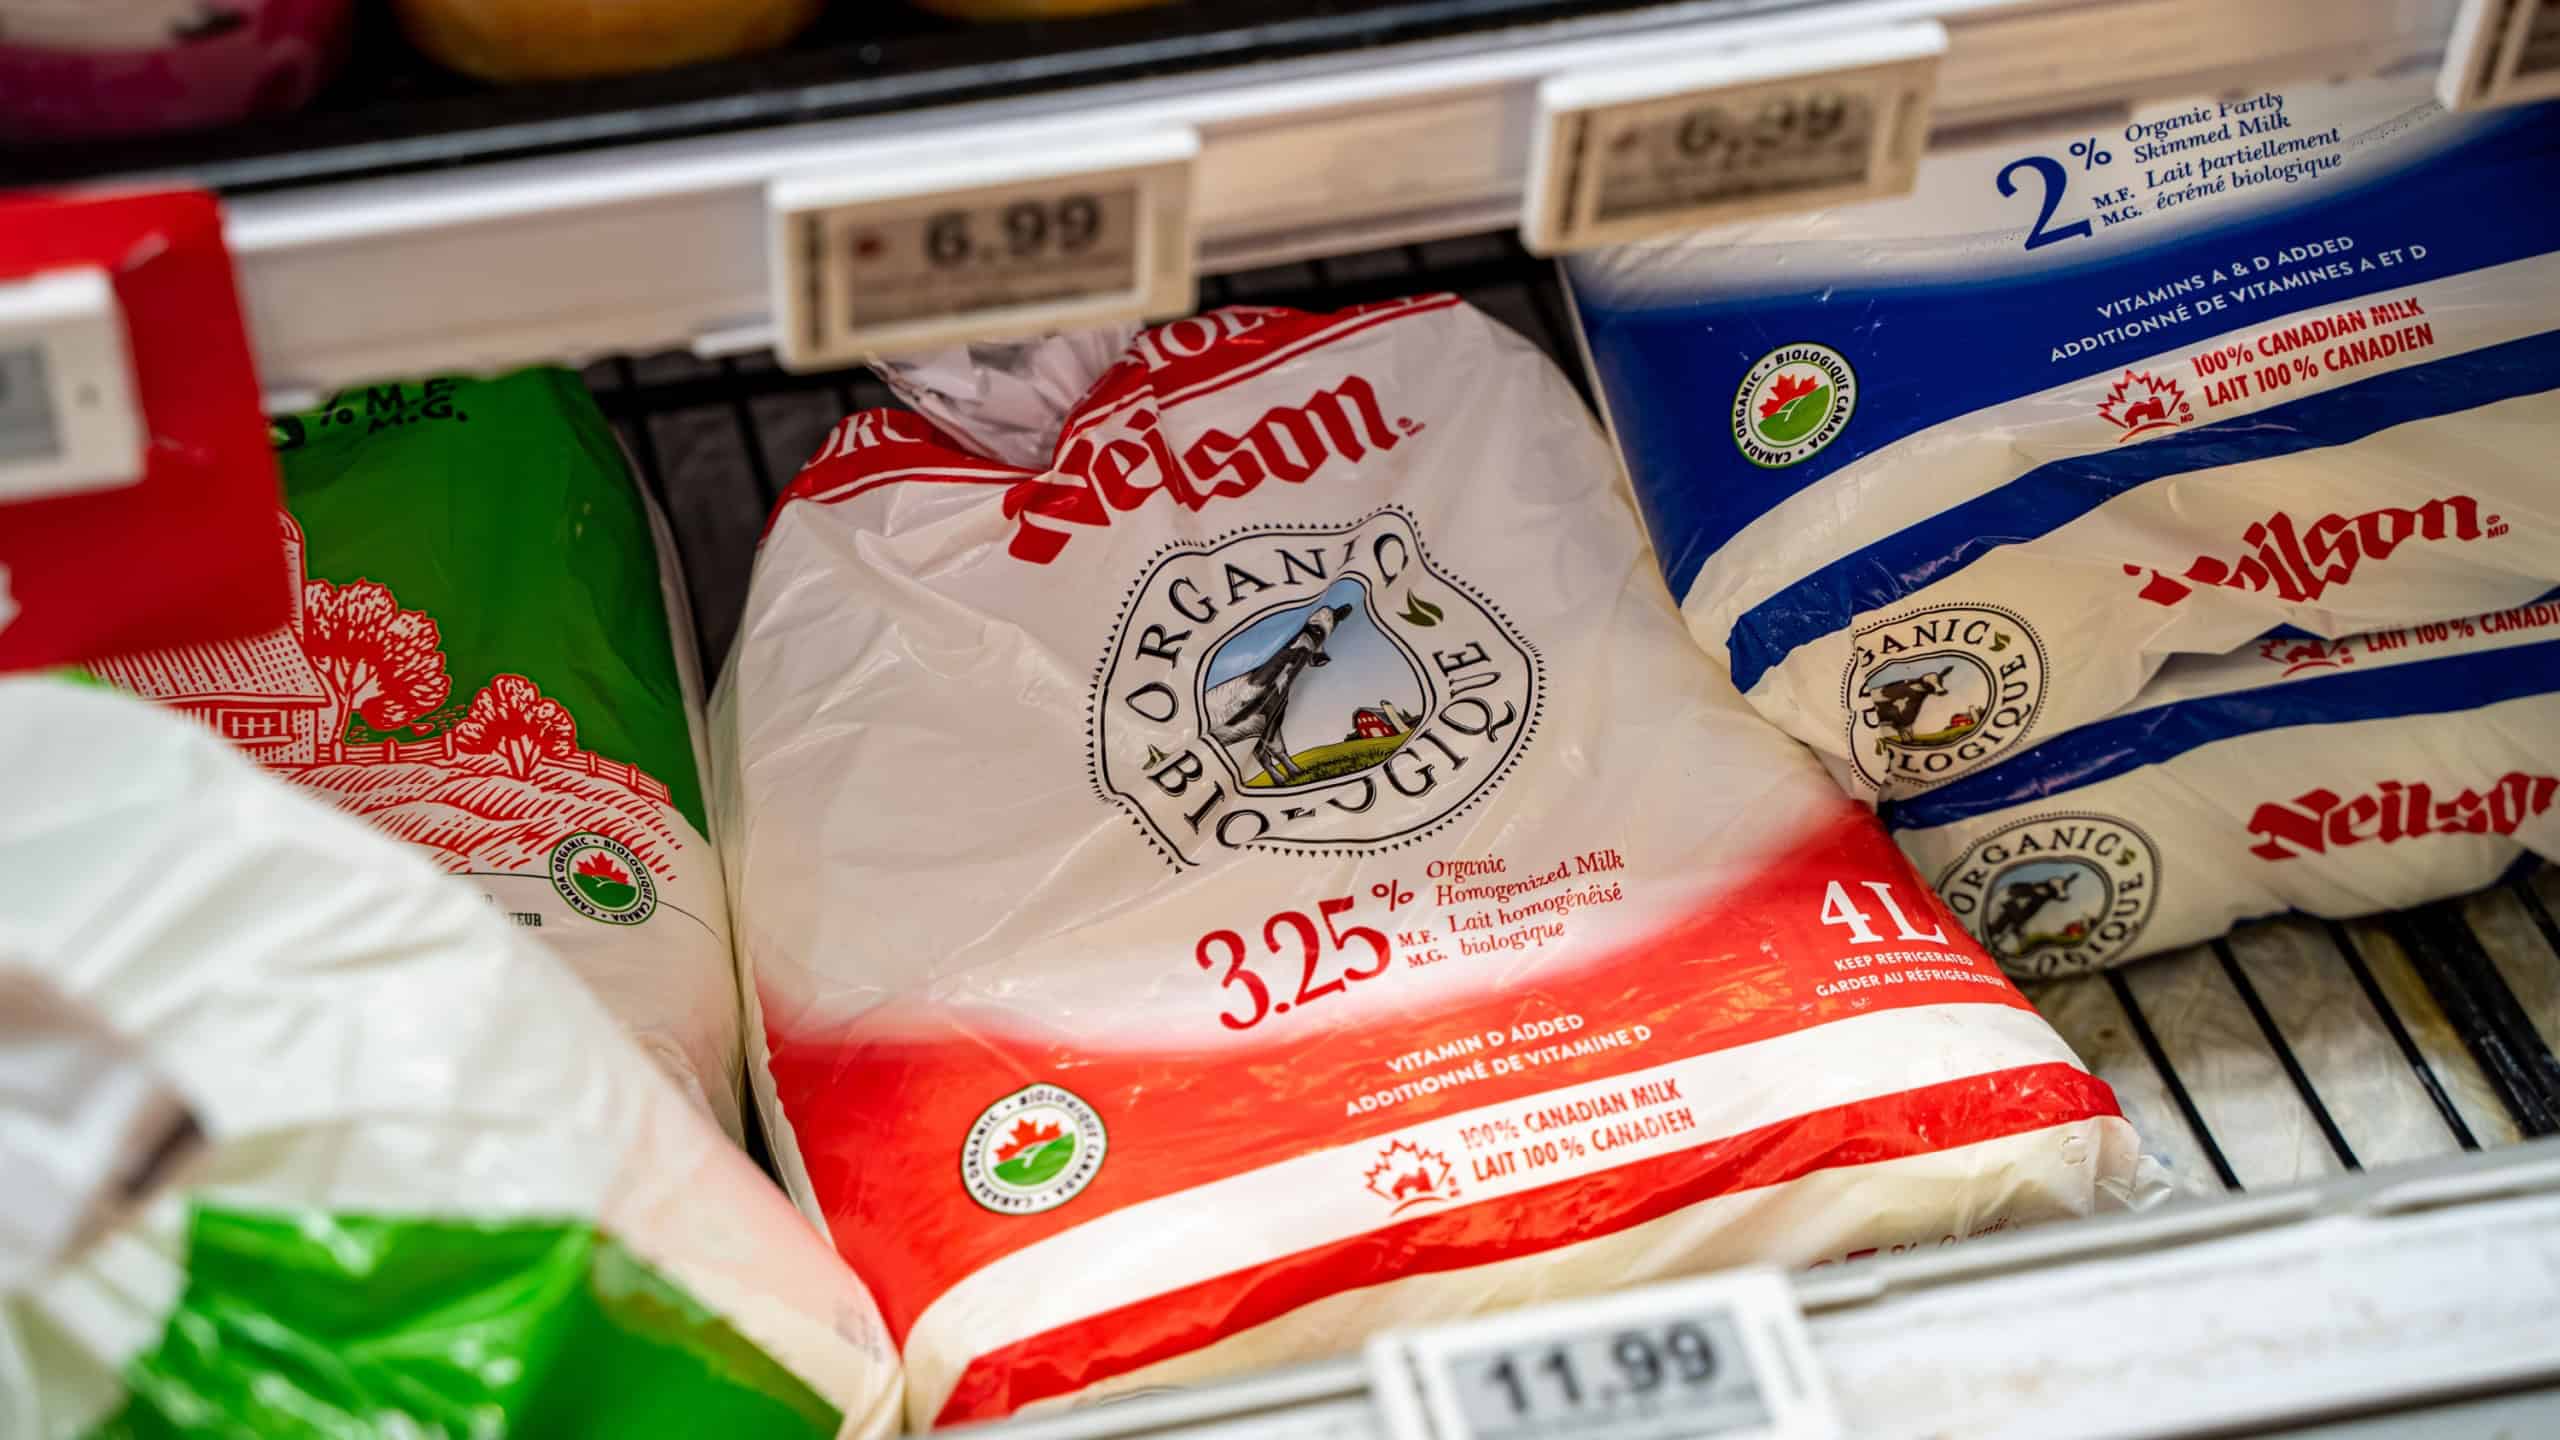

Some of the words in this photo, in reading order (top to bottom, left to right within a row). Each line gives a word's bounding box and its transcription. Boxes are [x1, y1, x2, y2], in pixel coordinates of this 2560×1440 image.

[2124, 107, 2212, 143] Organic
[2133, 127, 2232, 164] Skimmed
[2238, 112, 2291, 138] Milk
[2145, 162, 2193, 189] Lait
[2199, 127, 2342, 175] partiellement
[2156, 175, 2227, 210] écrémé
[2232, 152, 2343, 190] biologique
[2092, 186, 2136, 210] M.F.
[2101, 203, 2143, 227] M.G.
[925, 194, 1100, 267] 6.99
[2050, 303, 2193, 363] ADDITIONNÉ
[2196, 294, 2226, 316] DE
[2229, 263, 2355, 303] VITAMINES
[2360, 257, 2376, 273] A
[2382, 248, 2404, 268] ET
[2413, 244, 2428, 260] D
[2097, 274, 2206, 319] VITAMINS
[2212, 269, 2228, 286] A
[2231, 262, 2251, 278] &
[2253, 256, 2271, 273] D
[2277, 235, 2355, 267] ADDED
[2190, 342, 2255, 378] 100%
[2257, 310, 2367, 358] CANADIAN
[2371, 296, 2426, 328] MILK
[2203, 374, 2250, 409] LAIT
[2323, 322, 2434, 372] CANADIEN
[1775, 349, 1849, 392] BIOLOGIQUE
[1735, 371, 1762, 439] ORGANIC
[1808, 395, 1850, 448] CANADA
[1743, 438, 1792, 465] CANADA
[1124, 532, 1410, 724] ORGANIC
[2479, 602, 2560, 635] CANADI
[554, 837, 587, 873] ORGANIC
[604, 839, 653, 904] BIOLOGIQUE
[1426, 854, 1506, 884] Organic
[1435, 862, 1571, 906] Homogenized
[1576, 849, 1625, 875] Milk
[1950, 825, 2121, 916] ORGANIC
[1448, 910, 1493, 934] Lait
[1498, 881, 1624, 927] homogénéisé
[1398, 930, 1438, 949] M.F.
[1407, 948, 1448, 968] M.G.
[1460, 921, 1566, 957] biologique
[1834, 953, 1873, 972] KEEP
[1875, 951, 1975, 967] REFRIGERATED
[1815, 974, 1881, 997] GARDER
[1884, 971, 1904, 985] AU
[1345, 1059, 1487, 1117] ADDITIONNÉ
[1493, 1054, 1524, 1077] DE
[1524, 1029, 1630, 1067] VITAMINE
[1633, 1024, 1652, 1042] D
[1386, 1034, 1484, 1074] VITAMIN
[1487, 1030, 1505, 1048] D
[1511, 1013, 1584, 1042] ADDED
[1458, 1118, 1521, 1150] 100%
[1523, 1092, 1629, 1134] CANADIAN
[1631, 1077, 1684, 1109] MILK
[1471, 1150, 1517, 1182] LAIT
[1591, 1106, 1697, 1151] CANADIEN
[1487, 1320, 1717, 1412] 11.99
